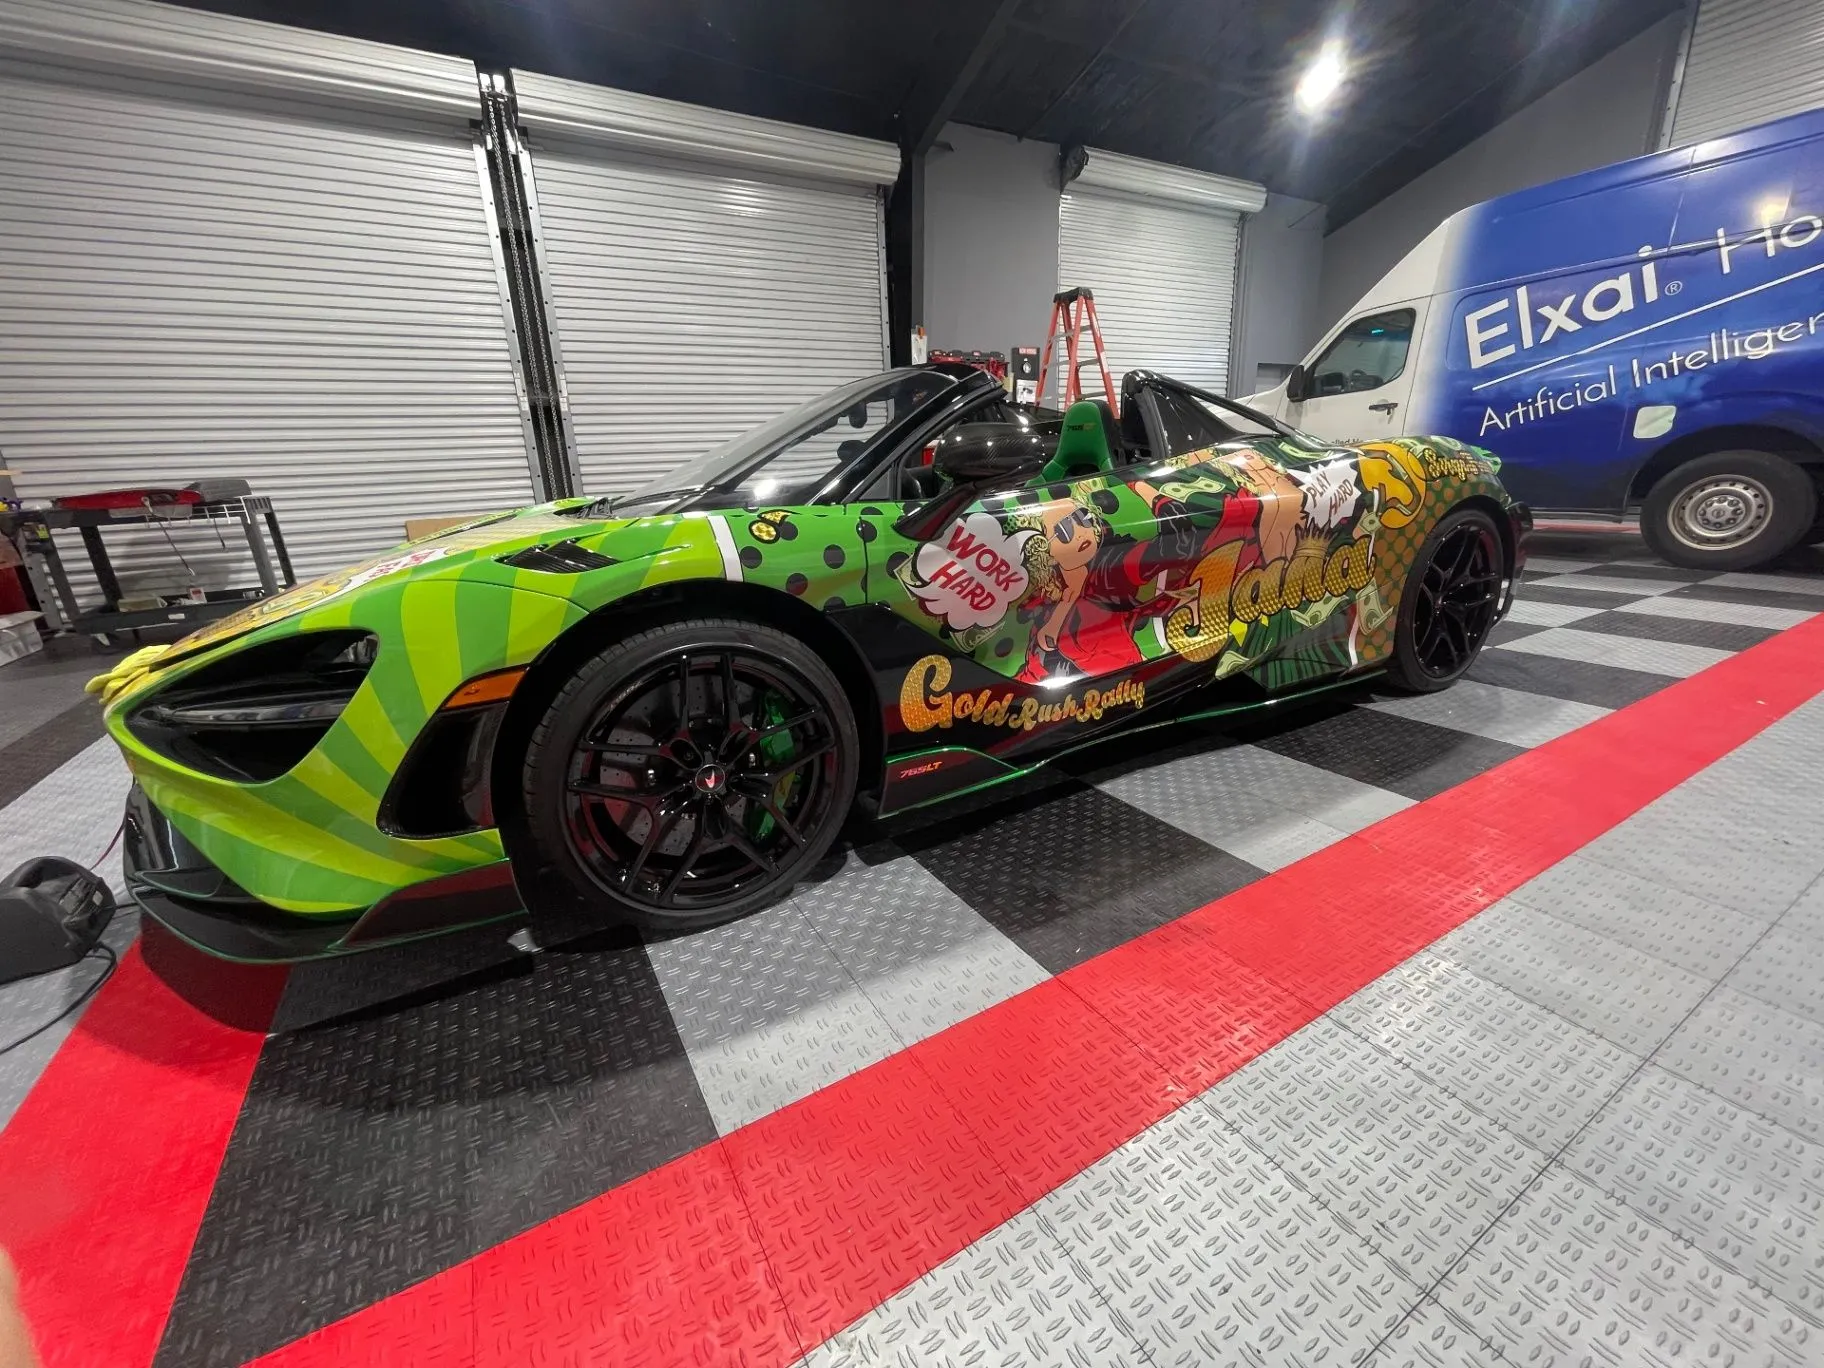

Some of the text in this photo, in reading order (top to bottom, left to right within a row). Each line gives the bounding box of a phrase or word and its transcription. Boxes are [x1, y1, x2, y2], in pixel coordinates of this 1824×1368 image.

[1479, 364, 1617, 437] Artificial
[1306, 470, 1331, 509] PLAY
[1329, 478, 1354, 515] HARD
[929, 560, 997, 611] HARD
[946, 525, 1024, 592] WORK
[1165, 534, 1377, 663] Jana
[900, 654, 1146, 733] Gold Rush Rally
[900, 761, 943, 779] 765LT
